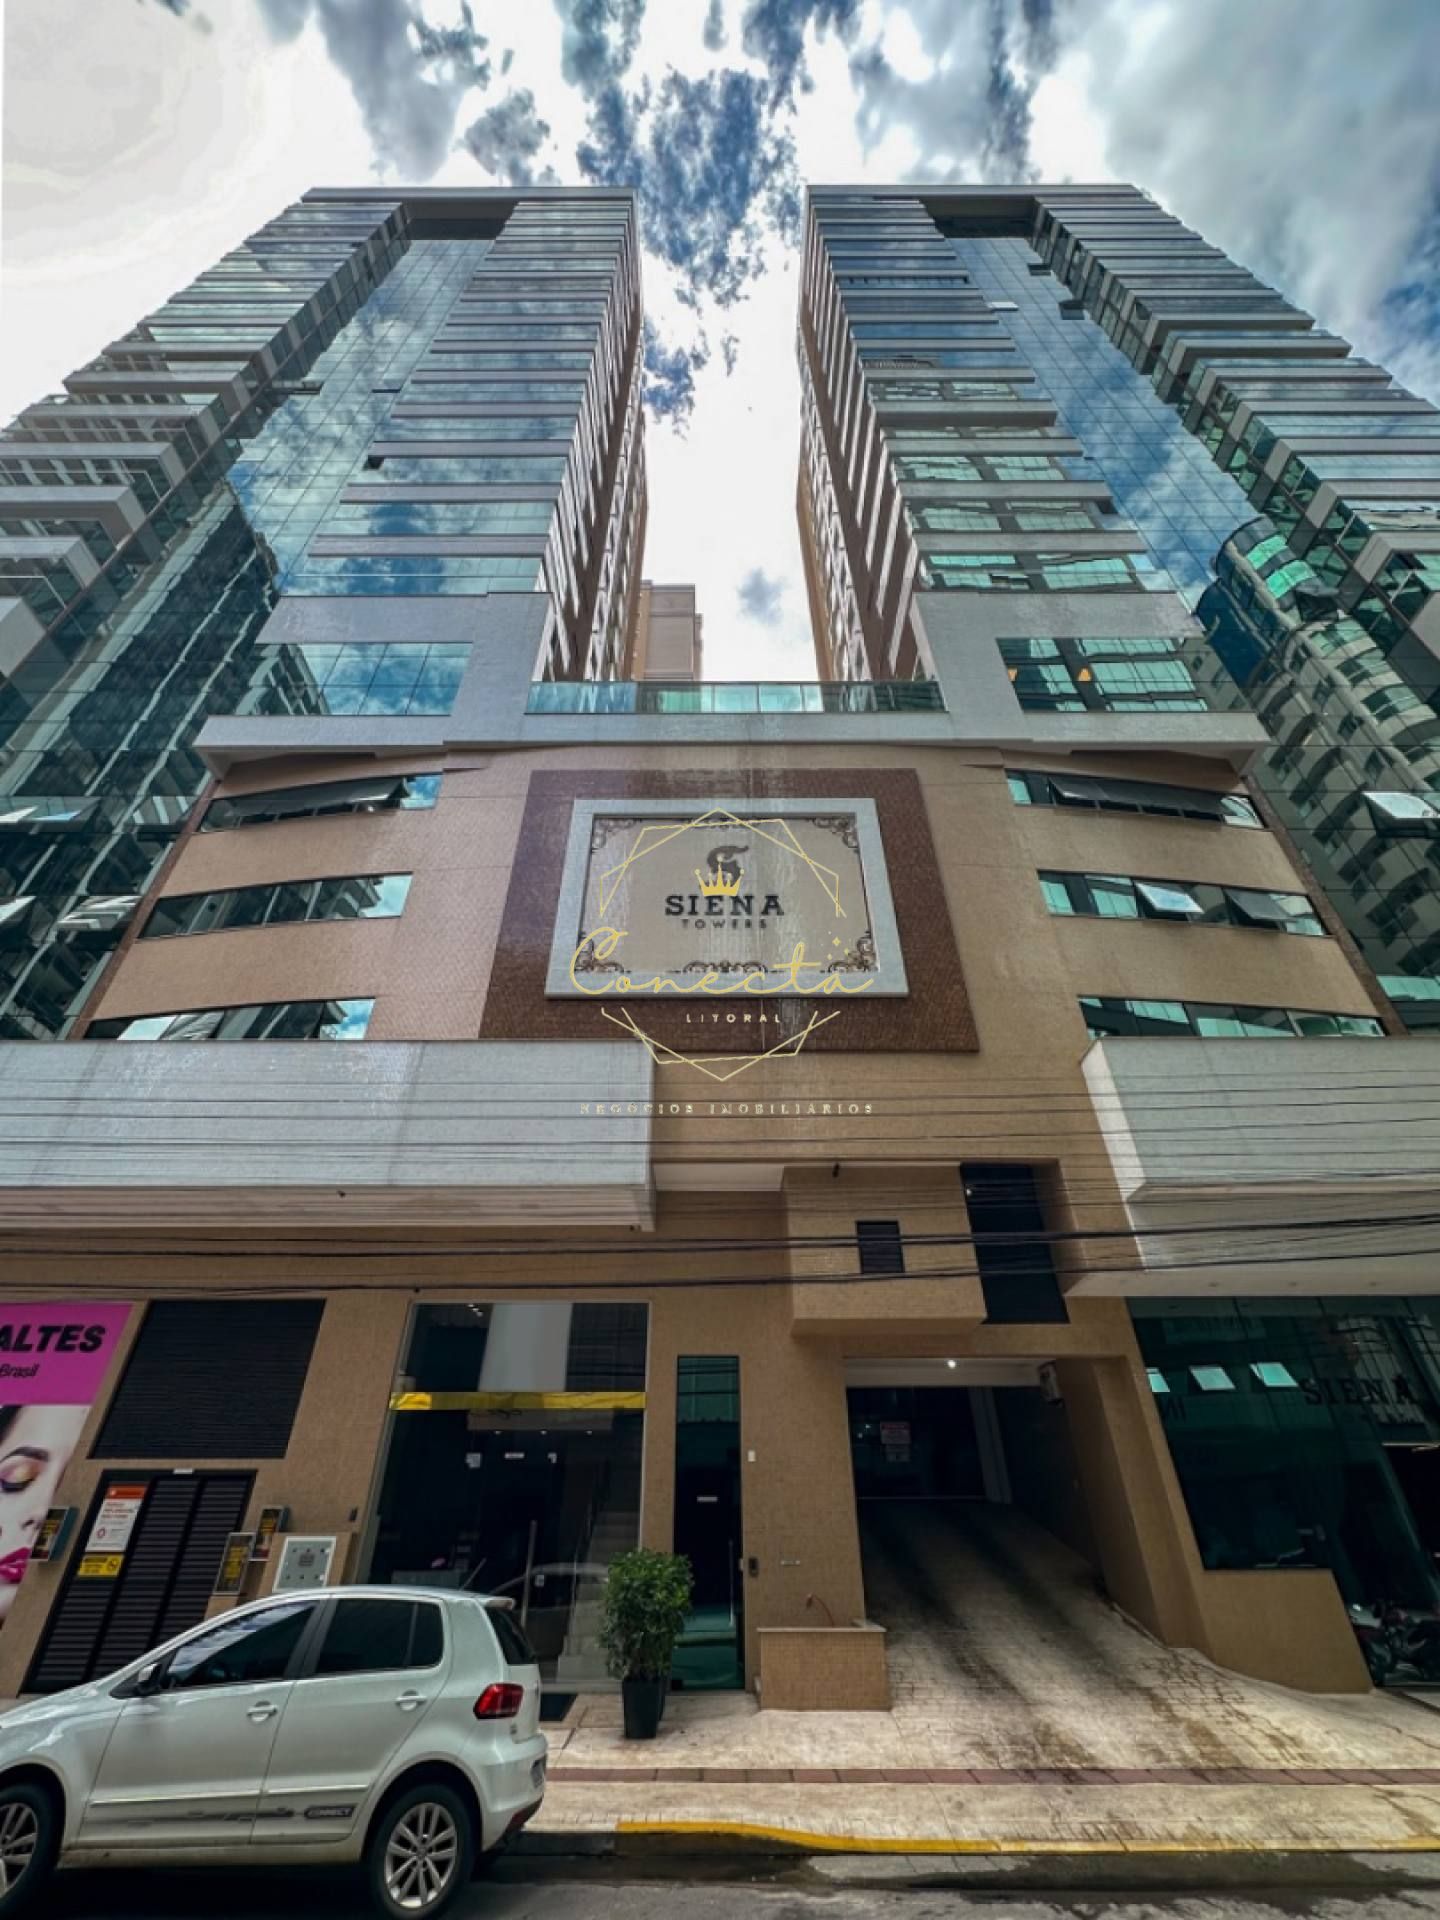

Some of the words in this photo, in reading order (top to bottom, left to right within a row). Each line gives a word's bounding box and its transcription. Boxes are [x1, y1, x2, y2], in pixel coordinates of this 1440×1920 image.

[664, 895, 784, 916] SIENA
[681, 918, 768, 930] TOWERS
[1299, 1375, 1424, 1405] SIENA
